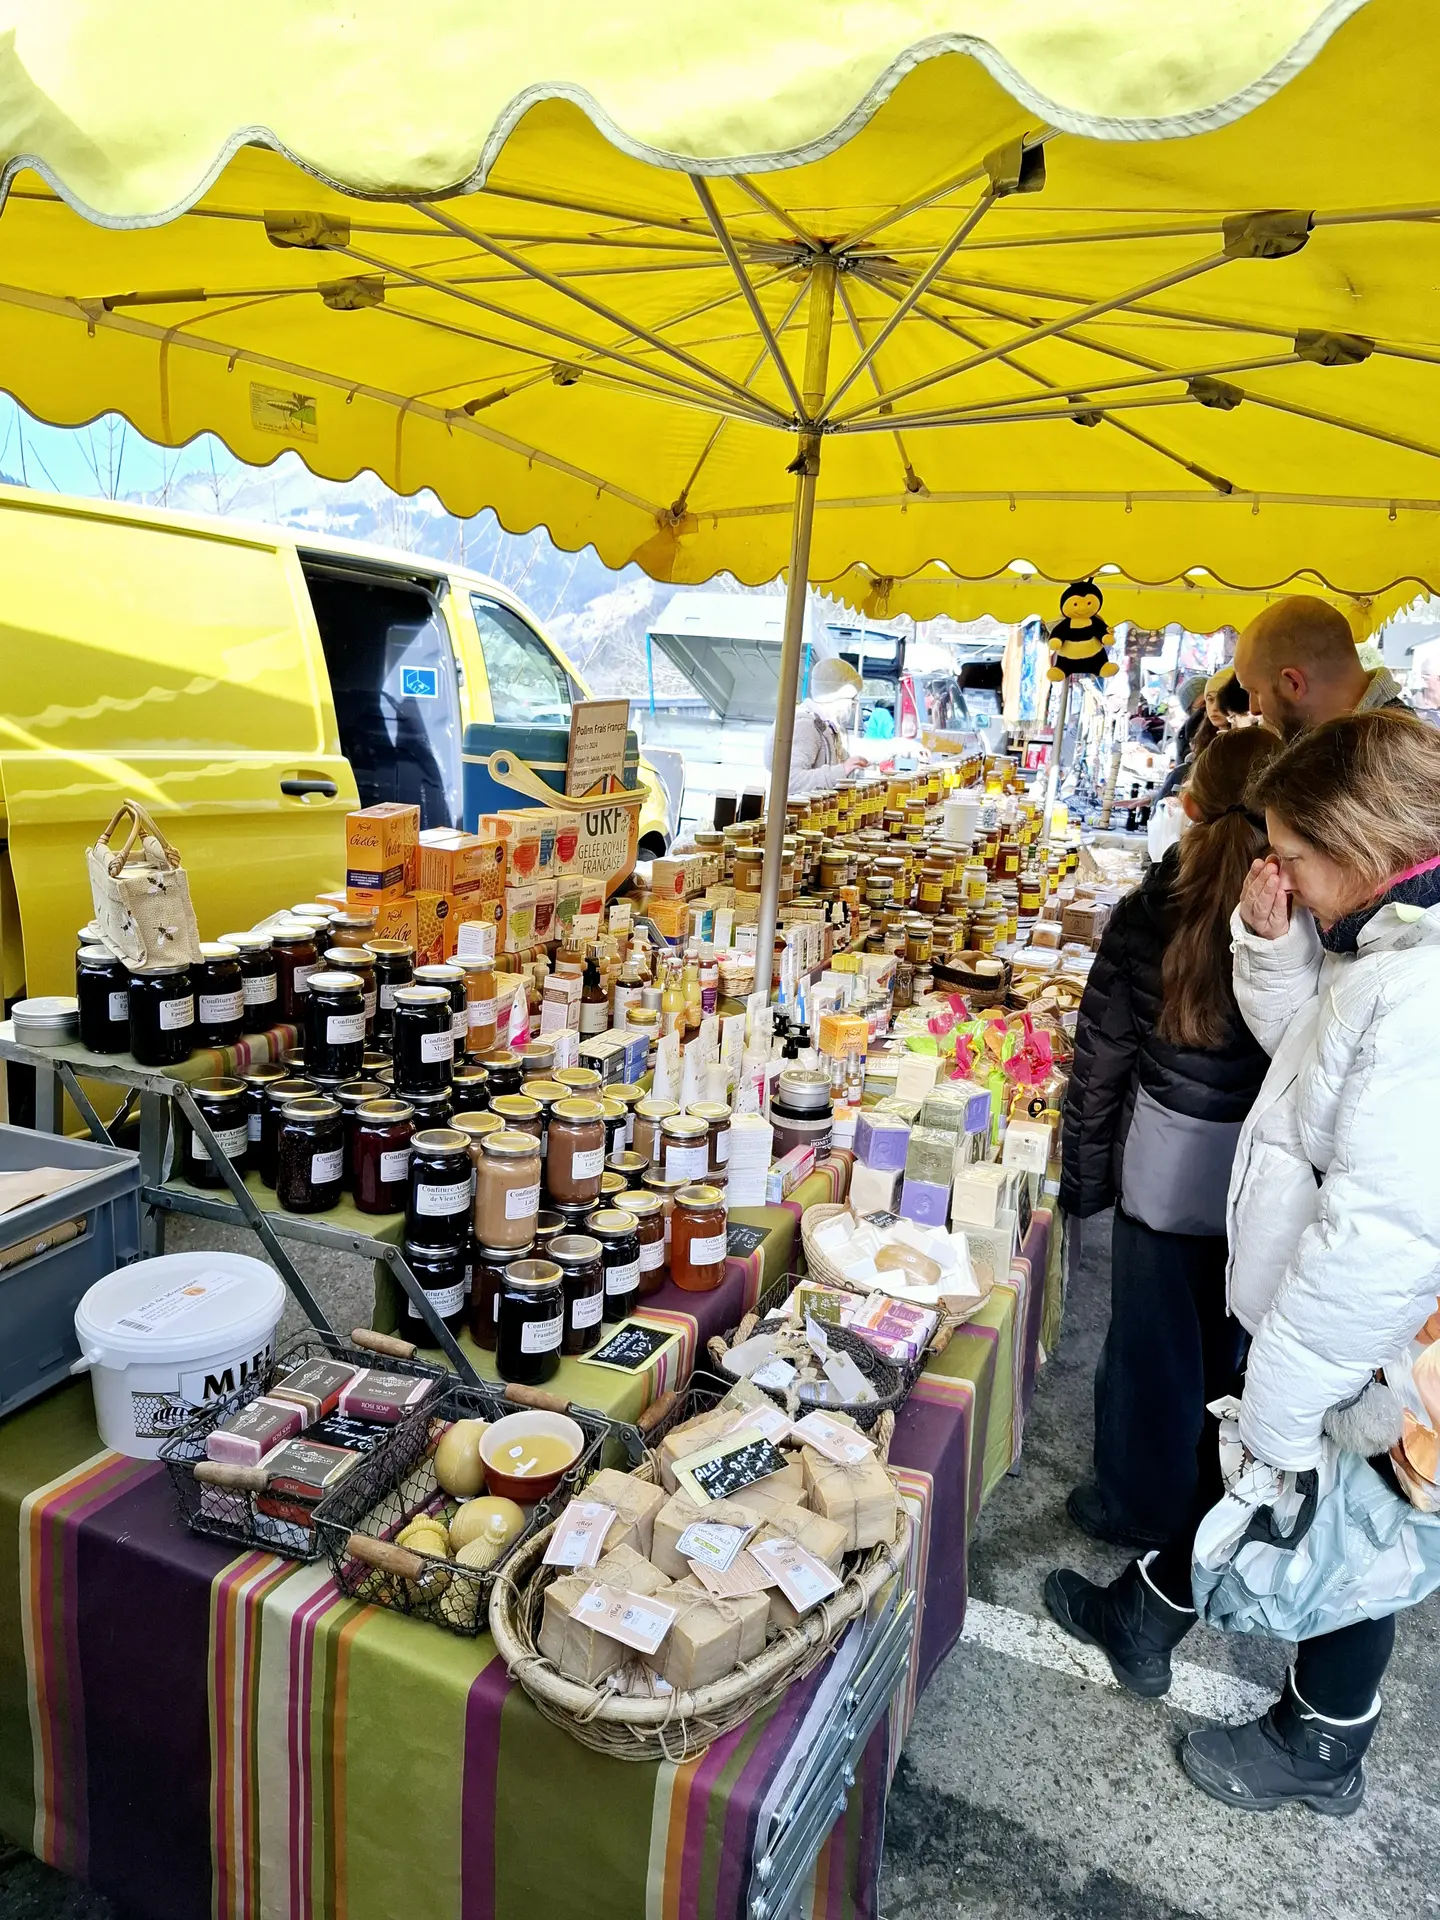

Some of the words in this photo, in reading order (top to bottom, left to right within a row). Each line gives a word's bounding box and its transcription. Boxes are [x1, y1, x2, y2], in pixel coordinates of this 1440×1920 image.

[576, 725, 594, 735] Pollen
[595, 723, 606, 733] Frais
[608, 721, 626, 732] Français
[579, 840, 600, 859] GELÉE
[603, 839, 626, 856] ROYALE
[582, 856, 620, 875] FRANÇAISE
[291, 1464, 307, 1472] SOAP
[695, 1457, 723, 1482] ALEP
[283, 1482, 299, 1490] SOAP
